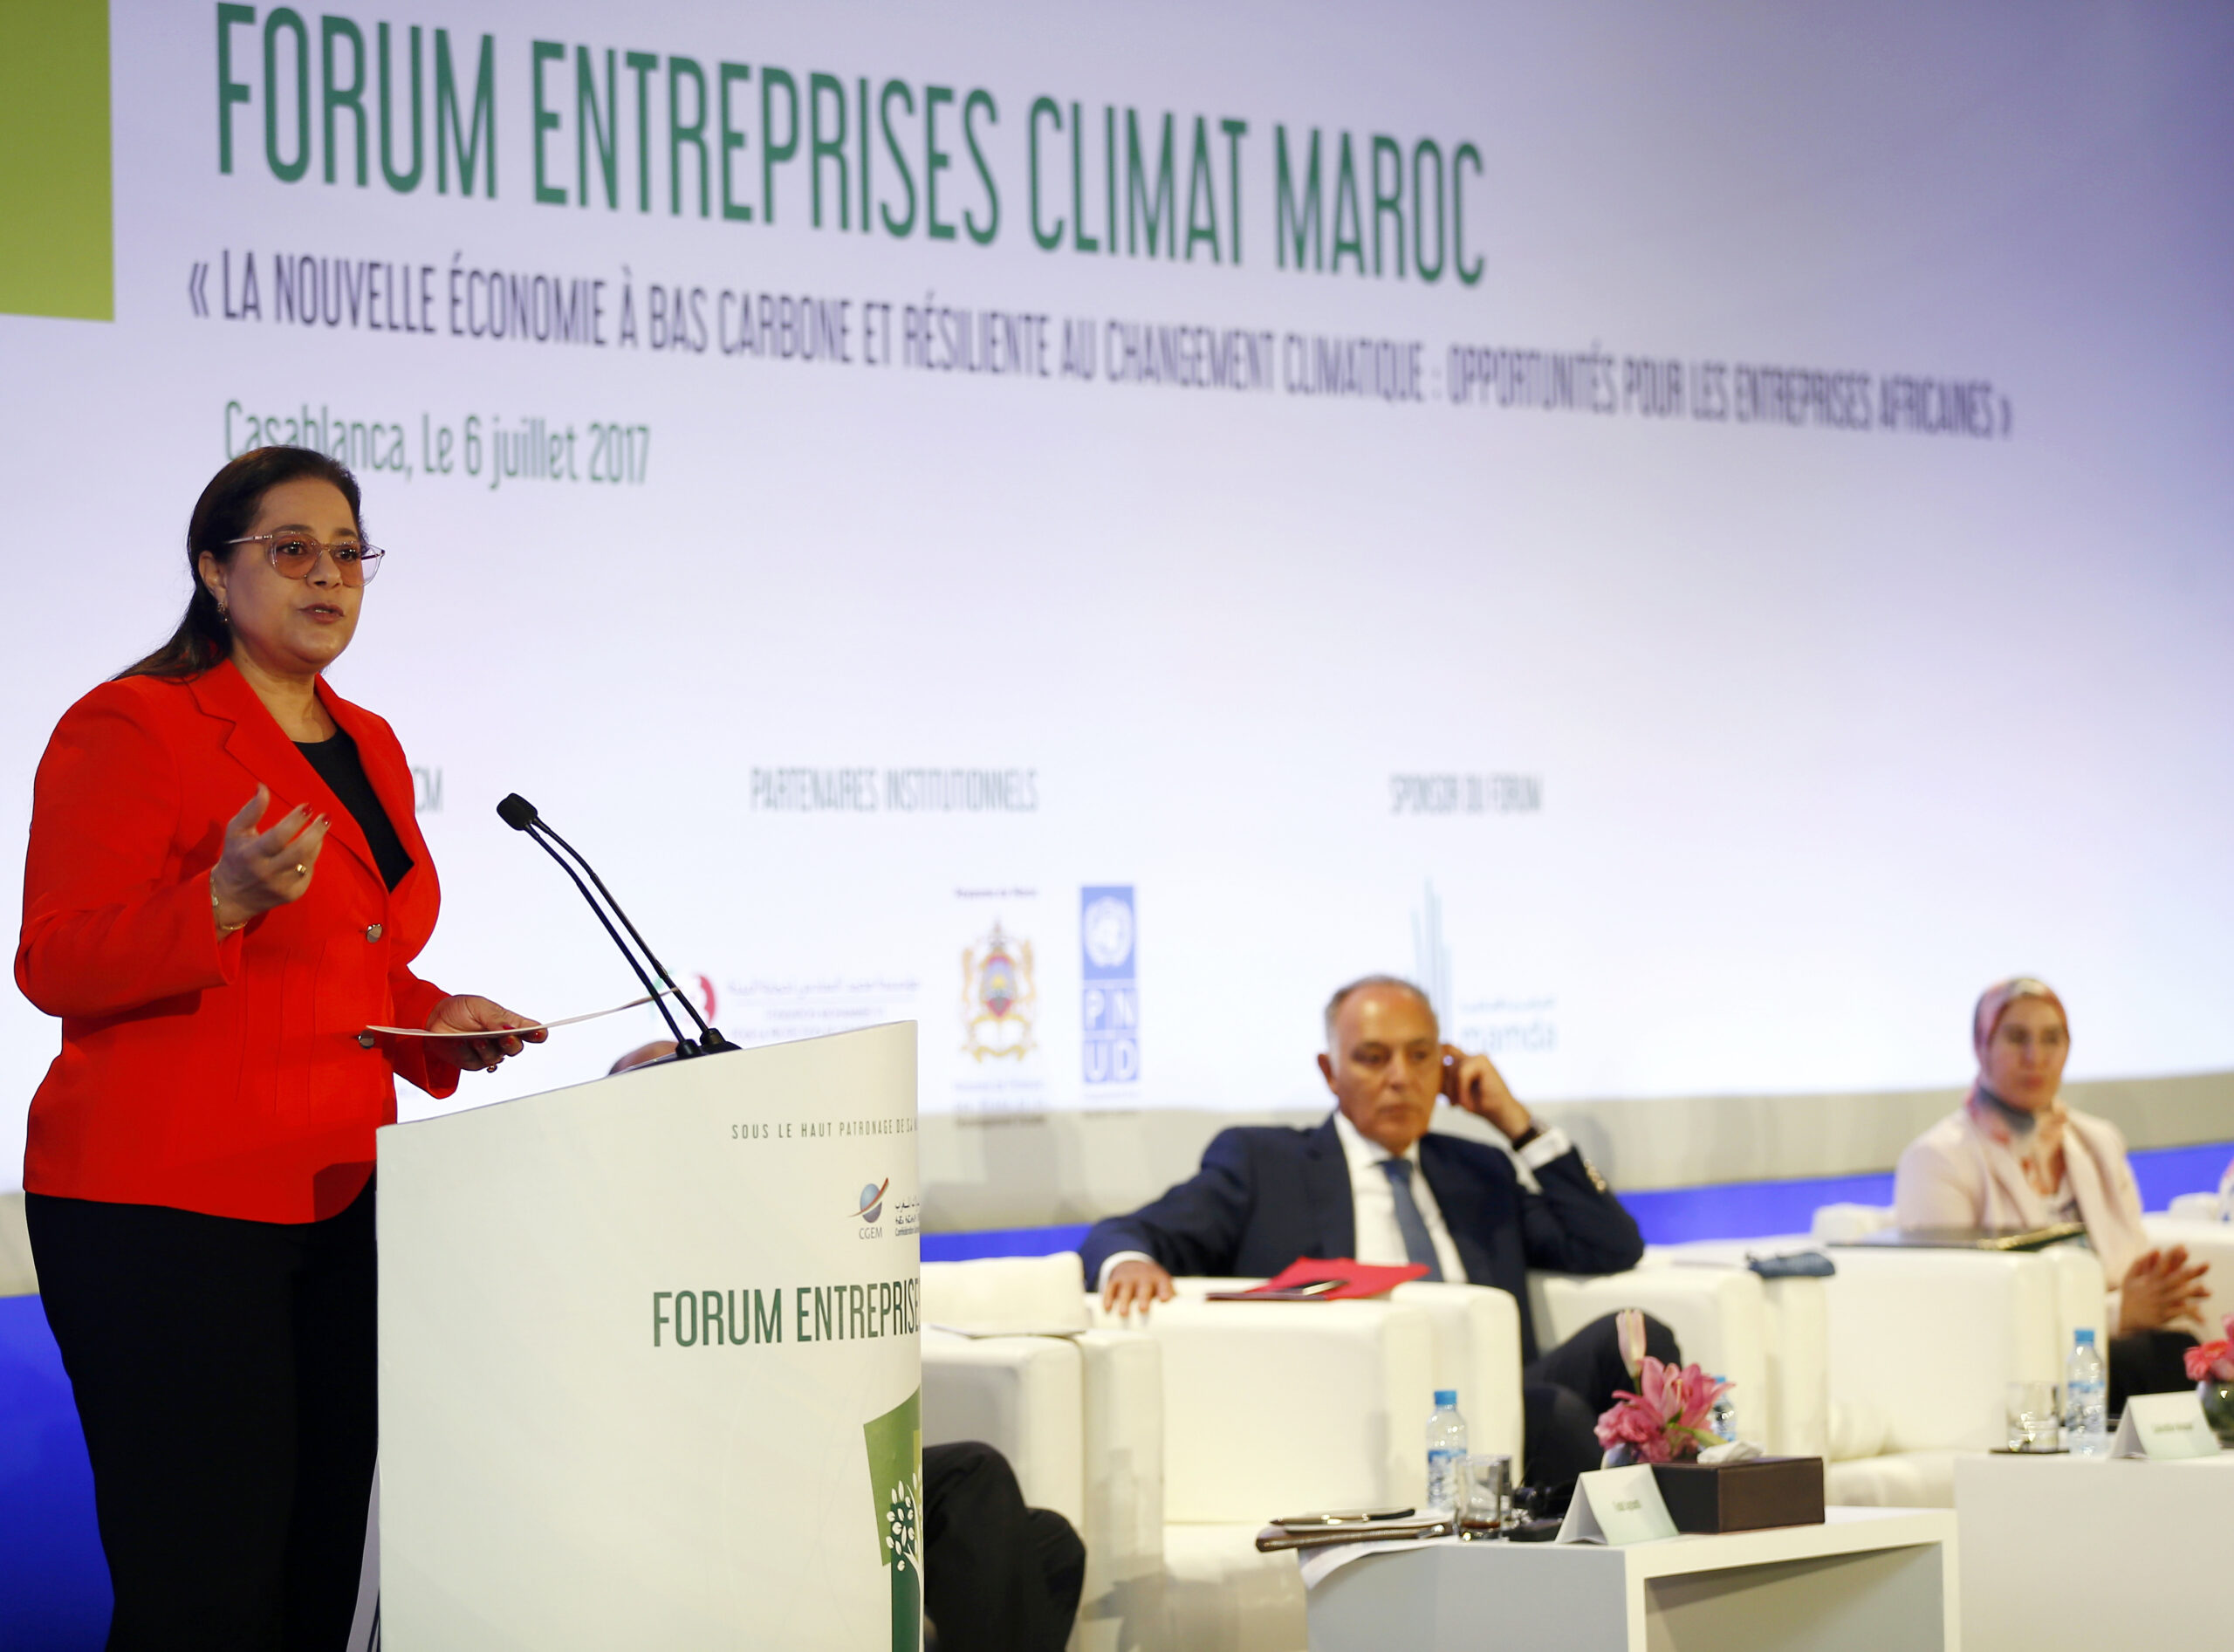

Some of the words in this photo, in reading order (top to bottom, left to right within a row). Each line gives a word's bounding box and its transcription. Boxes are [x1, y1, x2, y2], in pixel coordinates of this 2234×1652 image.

[216, 2, 498, 201] FORUM
[530, 38, 1002, 248] ENTREPRISES
[1026, 94, 1250, 267] CLIMAT
[1273, 121, 1486, 289] MAROC
[222, 248, 263, 322] LA
[274, 252, 438, 336] NOUVELLE
[448, 250, 608, 347] ÉCONOMIE
[618, 262, 640, 349] À
[648, 284, 709, 354] BAS
[717, 288, 853, 366] CARBONE
[863, 300, 892, 367] ET
[902, 288, 1052, 378] RÉSILIENTE
[1059, 318, 1097, 381] AU
[1104, 319, 1275, 394] CHANGEMENT
[1283, 332, 1425, 404] CLIMATIQUE
[1445, 338, 1620, 416] OPPORTUNITÉS
[1621, 356, 1688, 420] POUR
[1689, 359, 1730, 423] LES
[1733, 363, 1874, 431] ENTREPRISES
[1880, 373, 1997, 440] AFRICAINES
[422, 413, 455, 475] Le
[463, 414, 484, 479] 6
[488, 415, 580, 492] juillet
[587, 421, 651, 485] 2017
[750, 765, 881, 813] PARTENAIRES
[731, 1123, 769, 1140] SOUS
[778, 1123, 792, 1138] LE
[801, 1122, 833, 1137] HAUT
[839, 1119, 893, 1136] PATRONAGE
[896, 1118, 904, 1134] DE
[859, 1226, 883, 1240] CGEM
[653, 1288, 783, 1347] FORUM
[796, 1277, 921, 1343] ENTREPRISE
